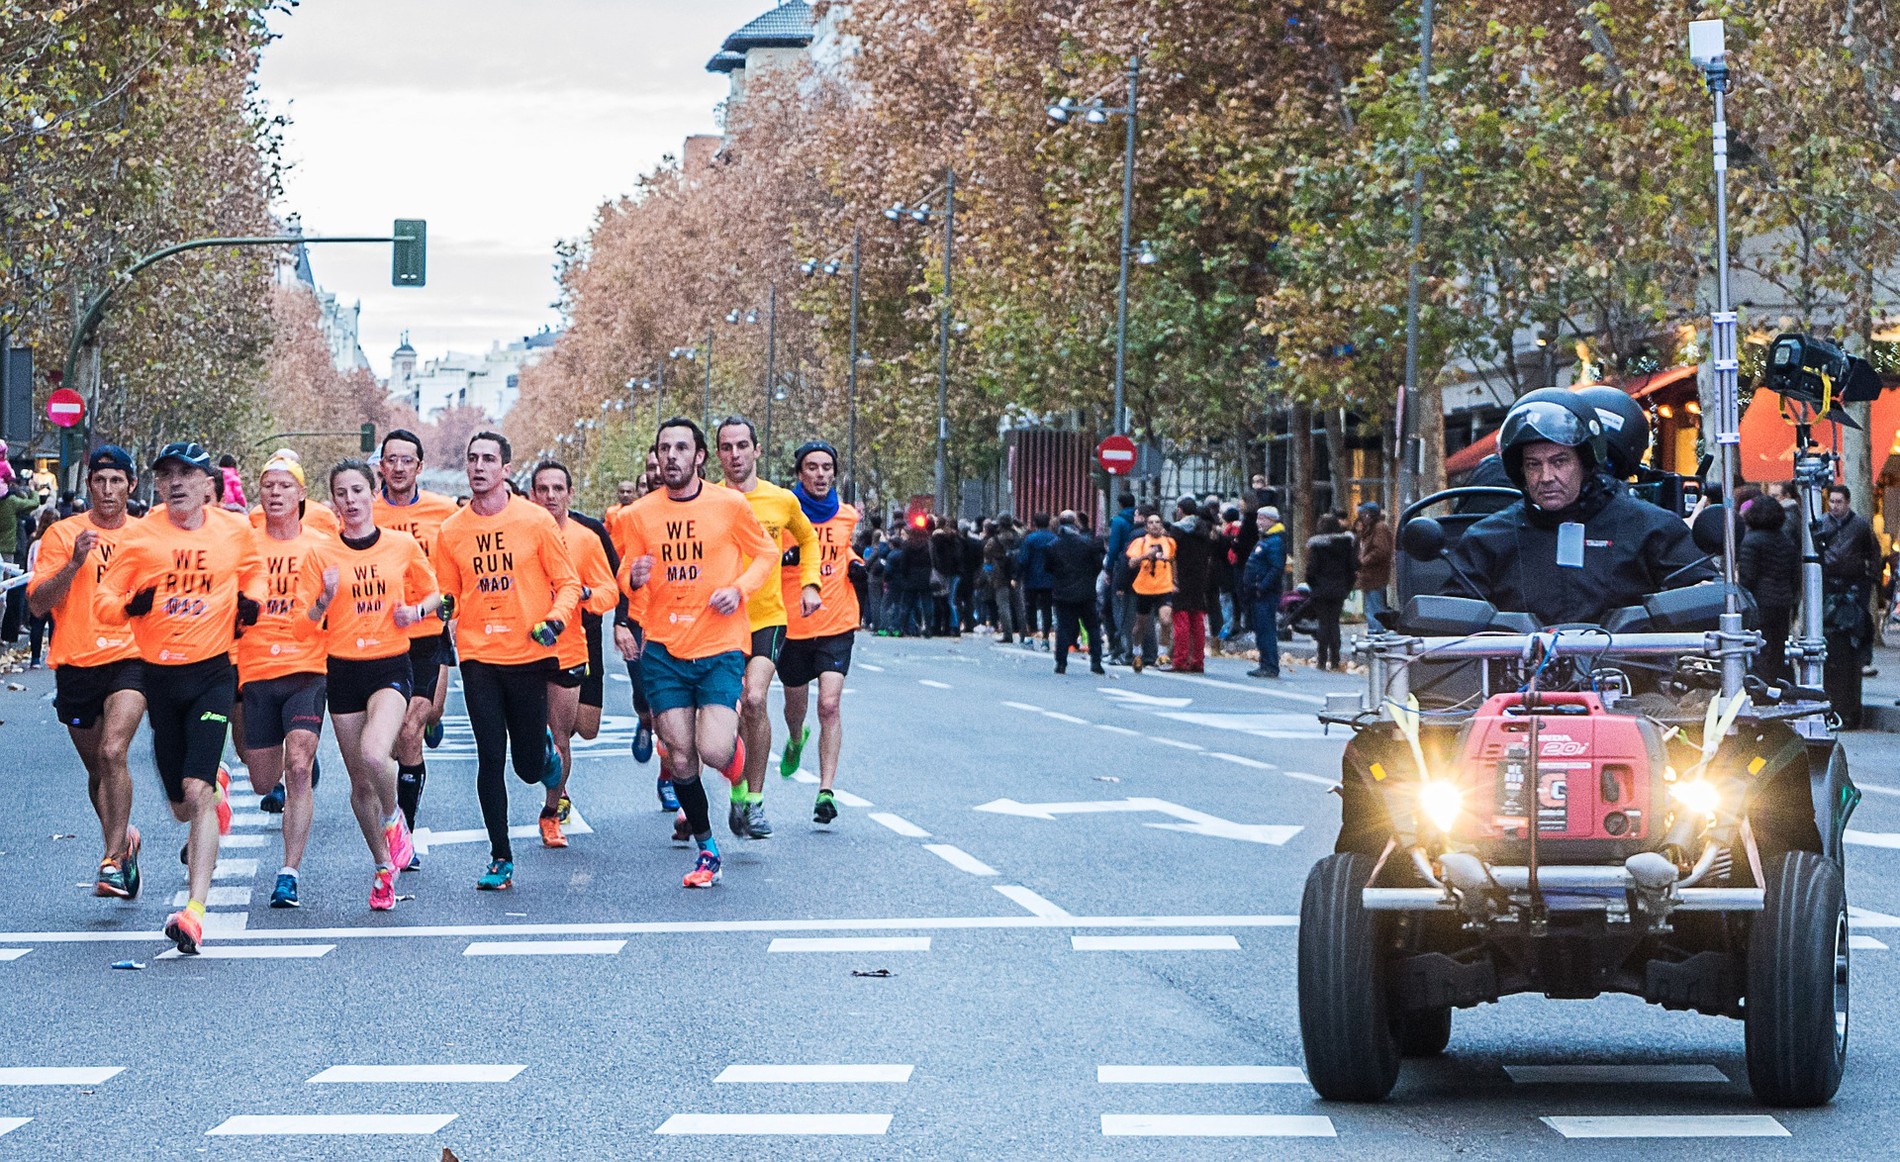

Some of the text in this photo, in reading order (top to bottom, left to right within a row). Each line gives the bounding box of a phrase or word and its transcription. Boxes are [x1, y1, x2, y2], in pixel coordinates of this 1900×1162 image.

[666, 520, 697, 540] WE
[476, 531, 506, 553] WE
[661, 541, 704, 562] RUN
[172, 549, 208, 571] WE
[267, 556, 300, 574] WE
[473, 552, 514, 575] RUN
[353, 564, 380, 581] WE
[667, 565, 698, 582] MAD
[166, 573, 215, 594] RUN
[352, 579, 386, 598] RUN
[479, 576, 511, 592] MAD
[356, 600, 382, 614] MAD
